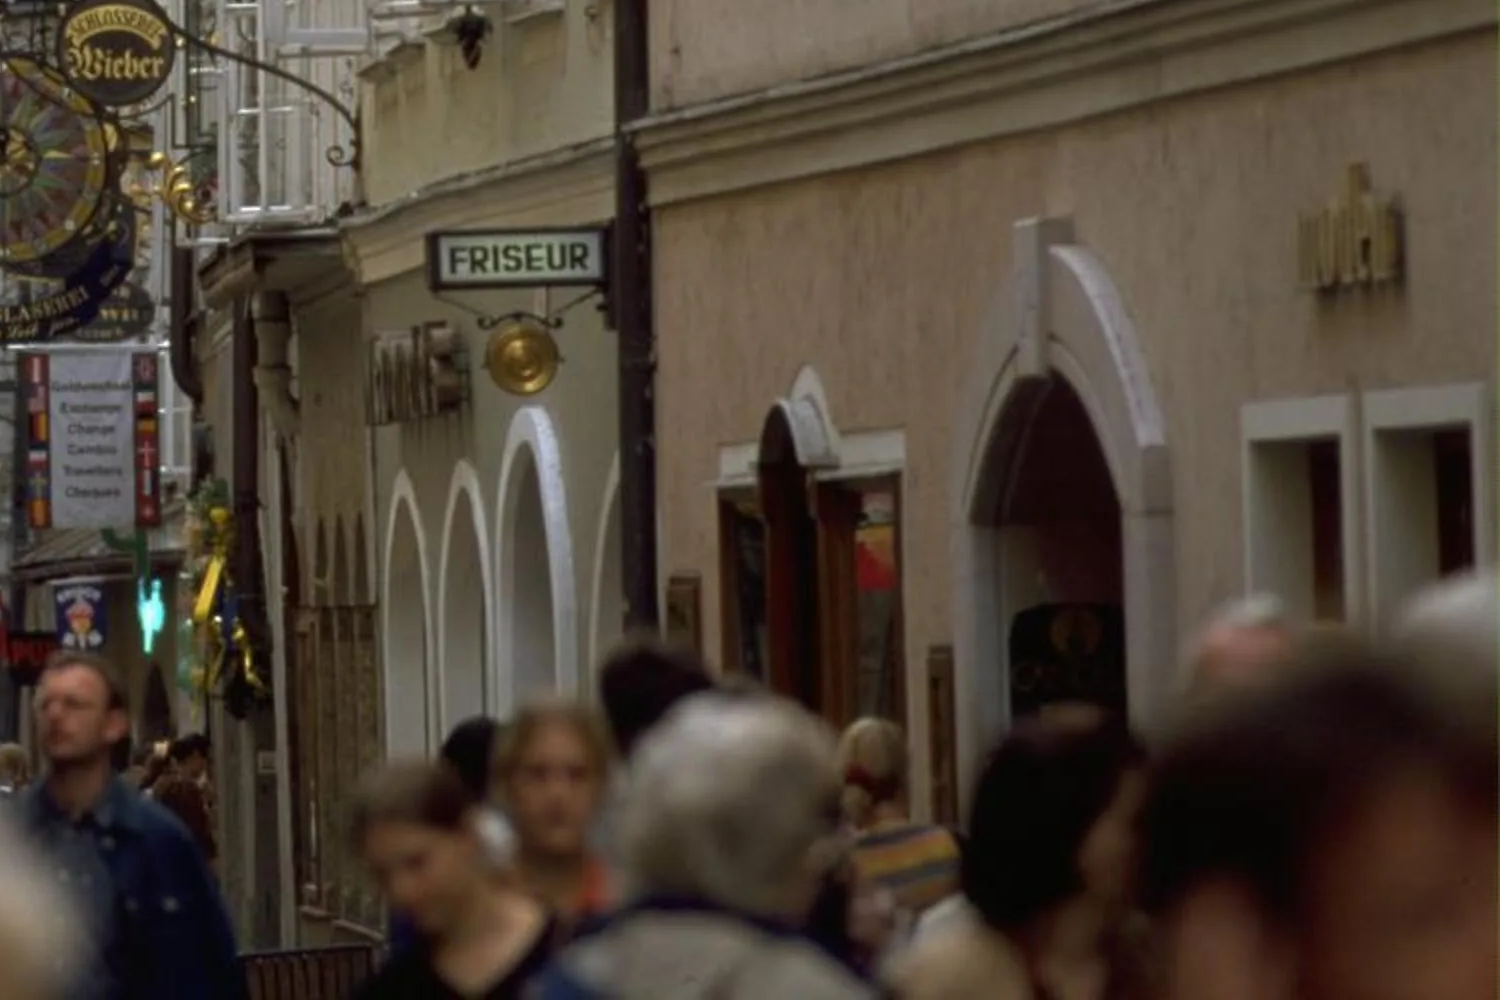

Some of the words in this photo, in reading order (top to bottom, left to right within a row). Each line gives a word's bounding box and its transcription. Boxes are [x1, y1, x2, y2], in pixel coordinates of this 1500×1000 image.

[68, 41, 164, 79] Wieber
[450, 243, 590, 275] FRISEUR
[67, 423, 115, 435] Change
